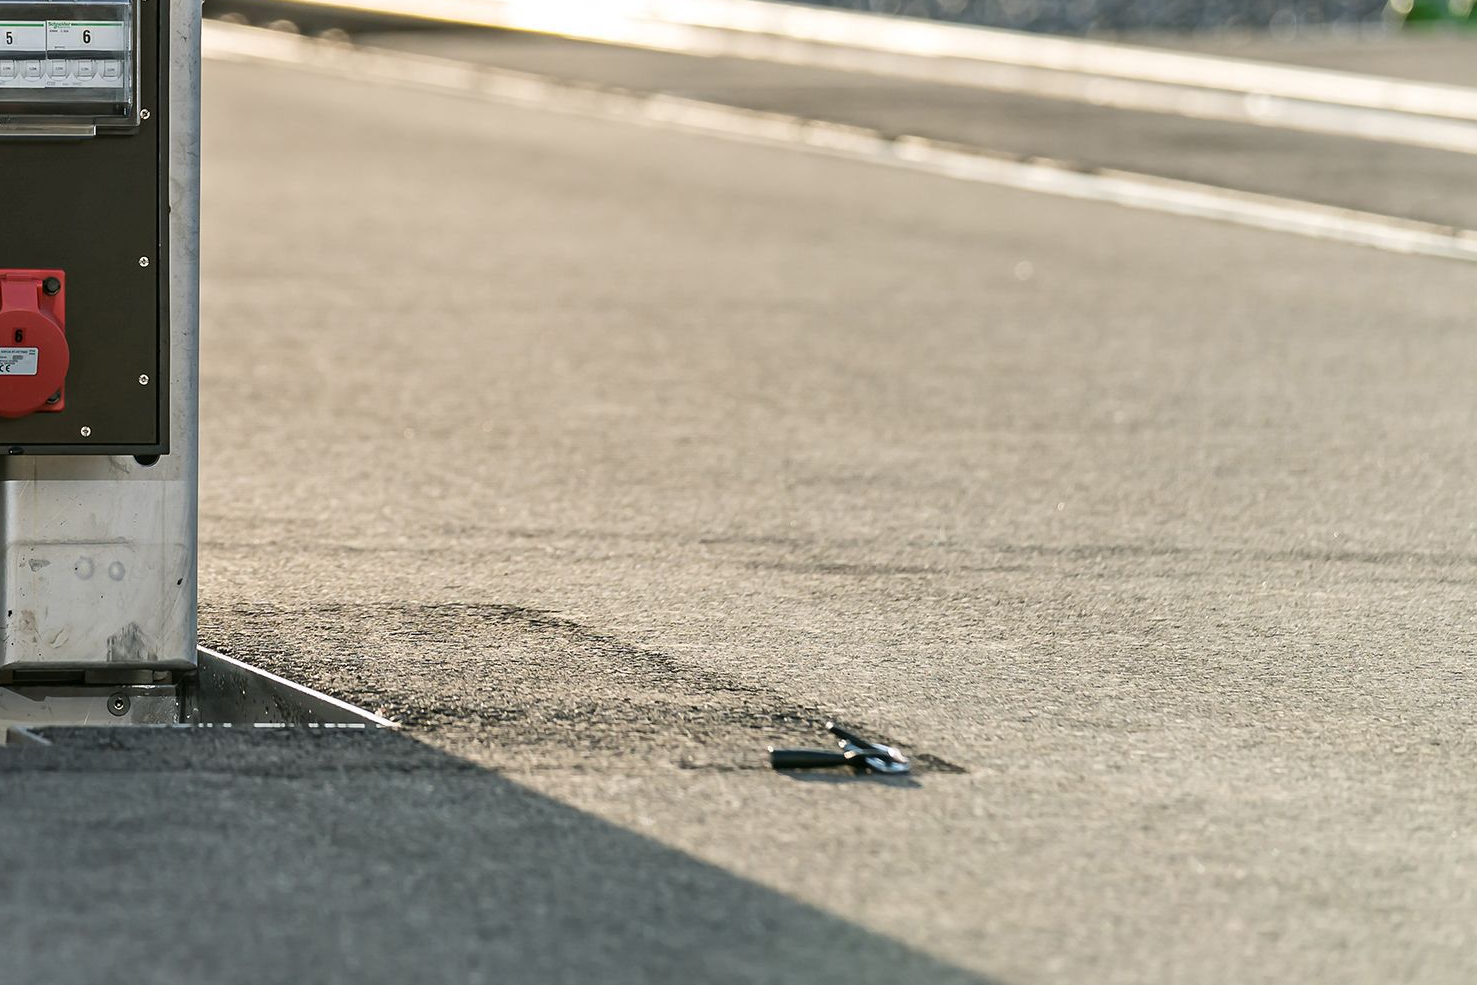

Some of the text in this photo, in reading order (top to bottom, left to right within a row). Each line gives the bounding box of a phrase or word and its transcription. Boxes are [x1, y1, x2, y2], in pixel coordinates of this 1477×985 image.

[6, 31, 13, 45] 5
[82, 30, 91, 44] 6
[15, 329, 23, 343] 6
[0, 364, 11, 373] CE
